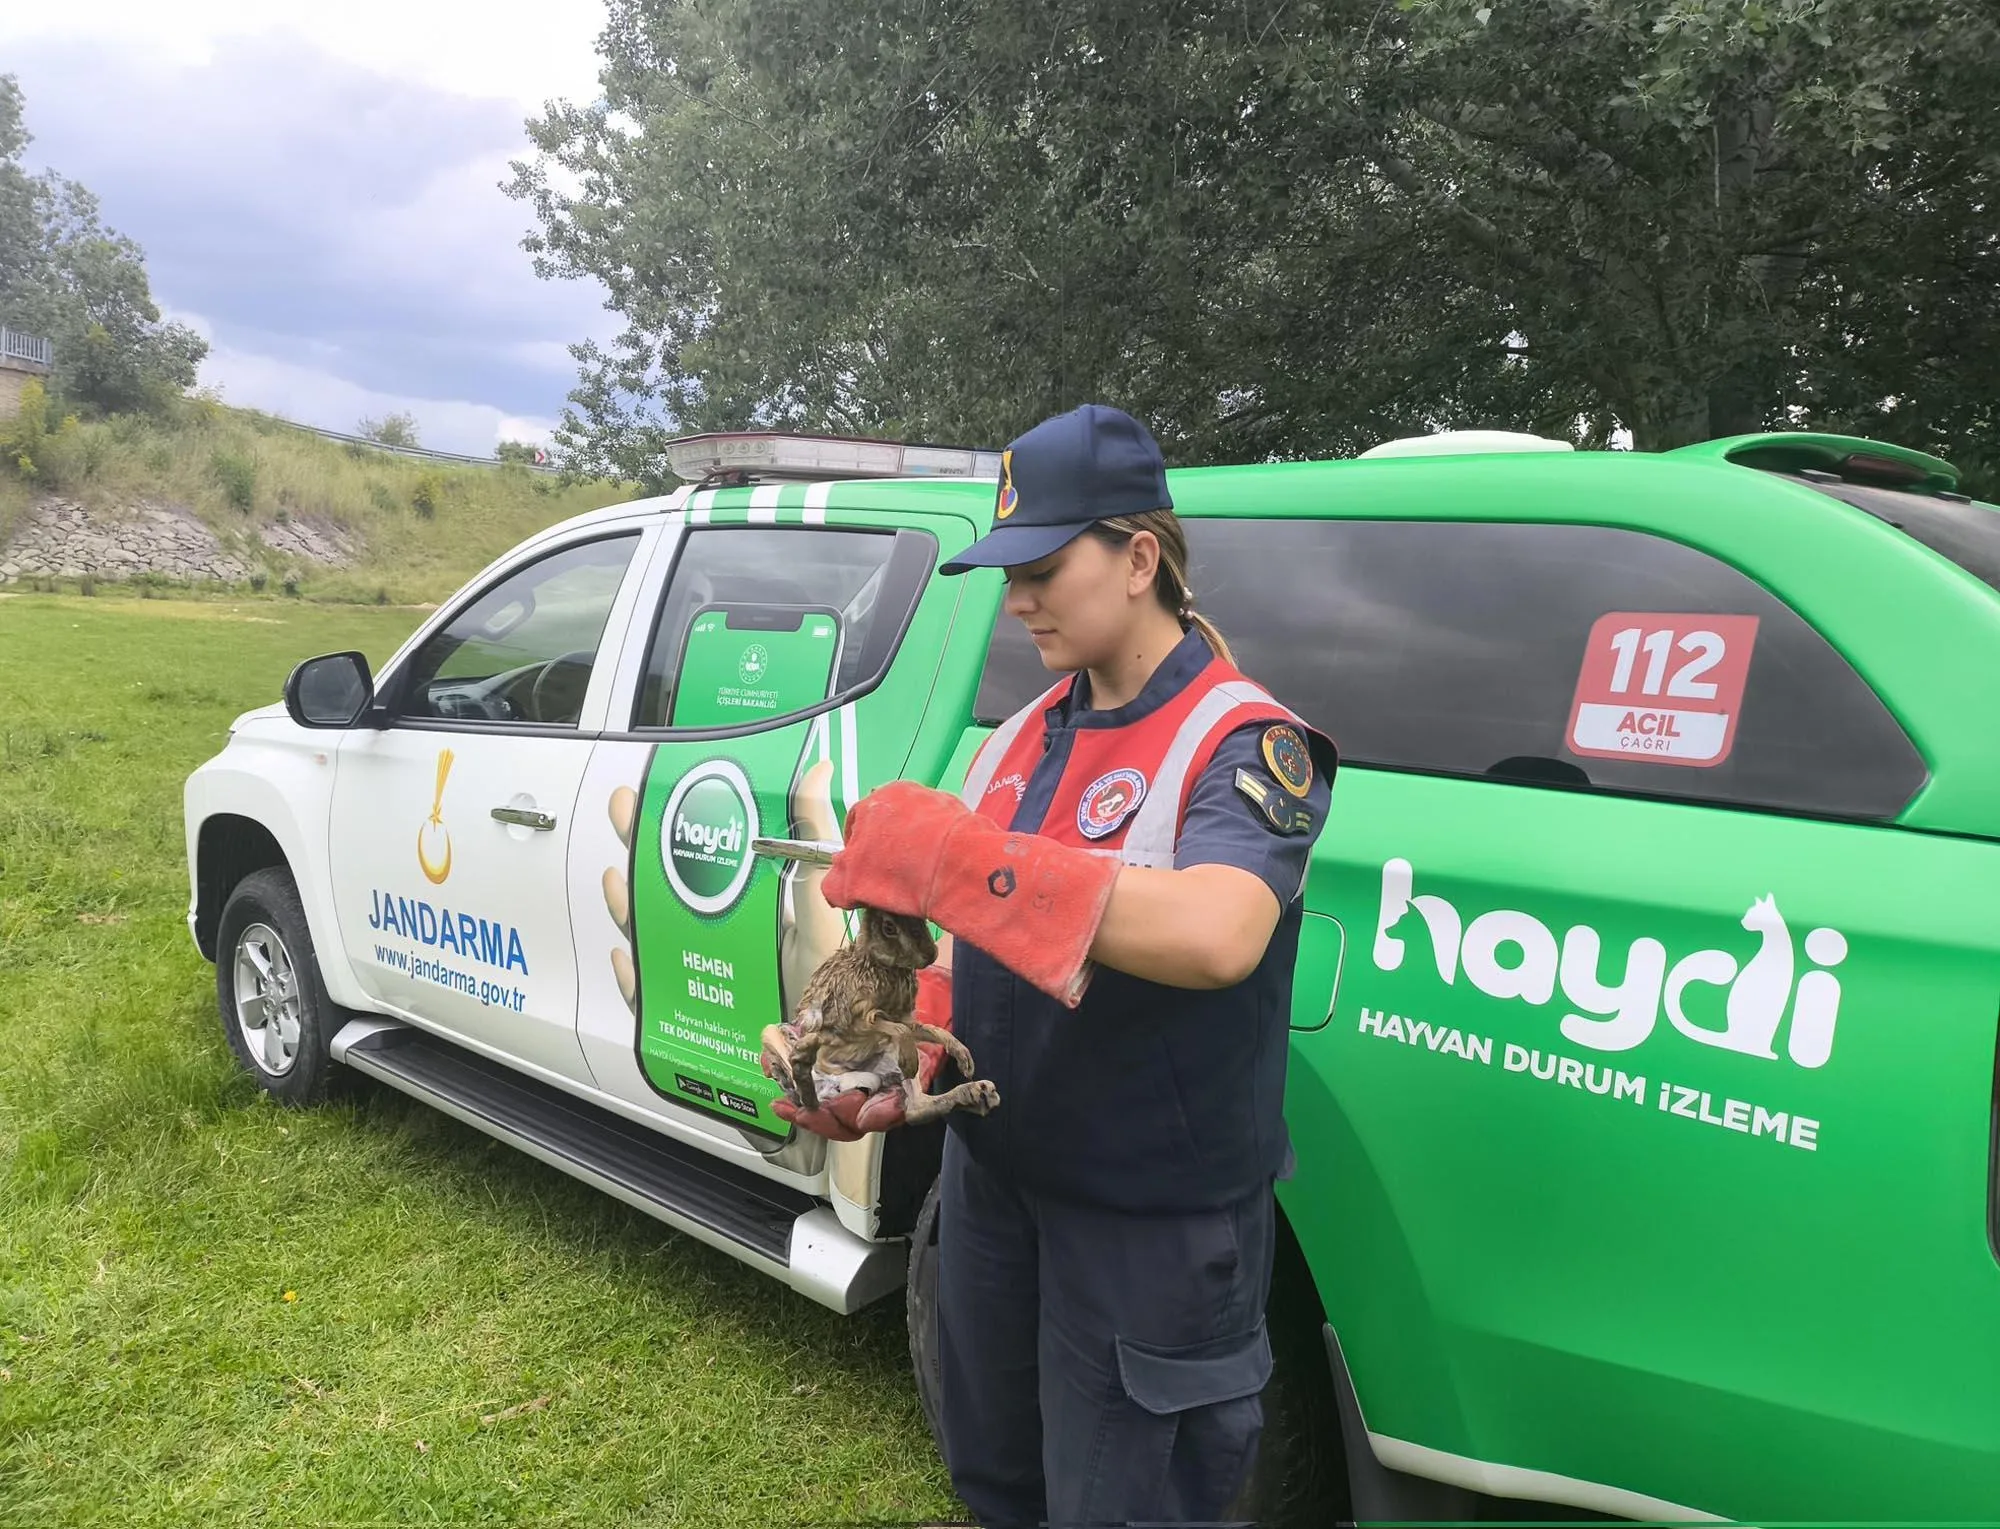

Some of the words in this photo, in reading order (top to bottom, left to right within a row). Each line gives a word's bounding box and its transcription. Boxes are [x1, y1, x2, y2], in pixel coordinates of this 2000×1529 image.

[1610, 628, 1726, 700] 112
[1620, 736, 1671, 752] ÇAĞRI
[675, 812, 743, 854] haydi
[368, 889, 529, 976] JANDARMA
[374, 943, 526, 1012] www.jandarma.gov.tr
[682, 949, 734, 980] HEMEN
[1372, 857, 1849, 1069] haydi
[687, 975, 735, 1009] BİLDİR
[659, 1020, 675, 1036] TEK
[676, 1025, 735, 1057] DOKUNUŞUN
[736, 1045, 760, 1065] YETE
[674, 1009, 703, 1029] Hayvan
[704, 1017, 730, 1037] hakları
[731, 1028, 746, 1043] için
[1358, 1007, 1493, 1065] HAYVAN
[1503, 1042, 1646, 1105] DURUM
